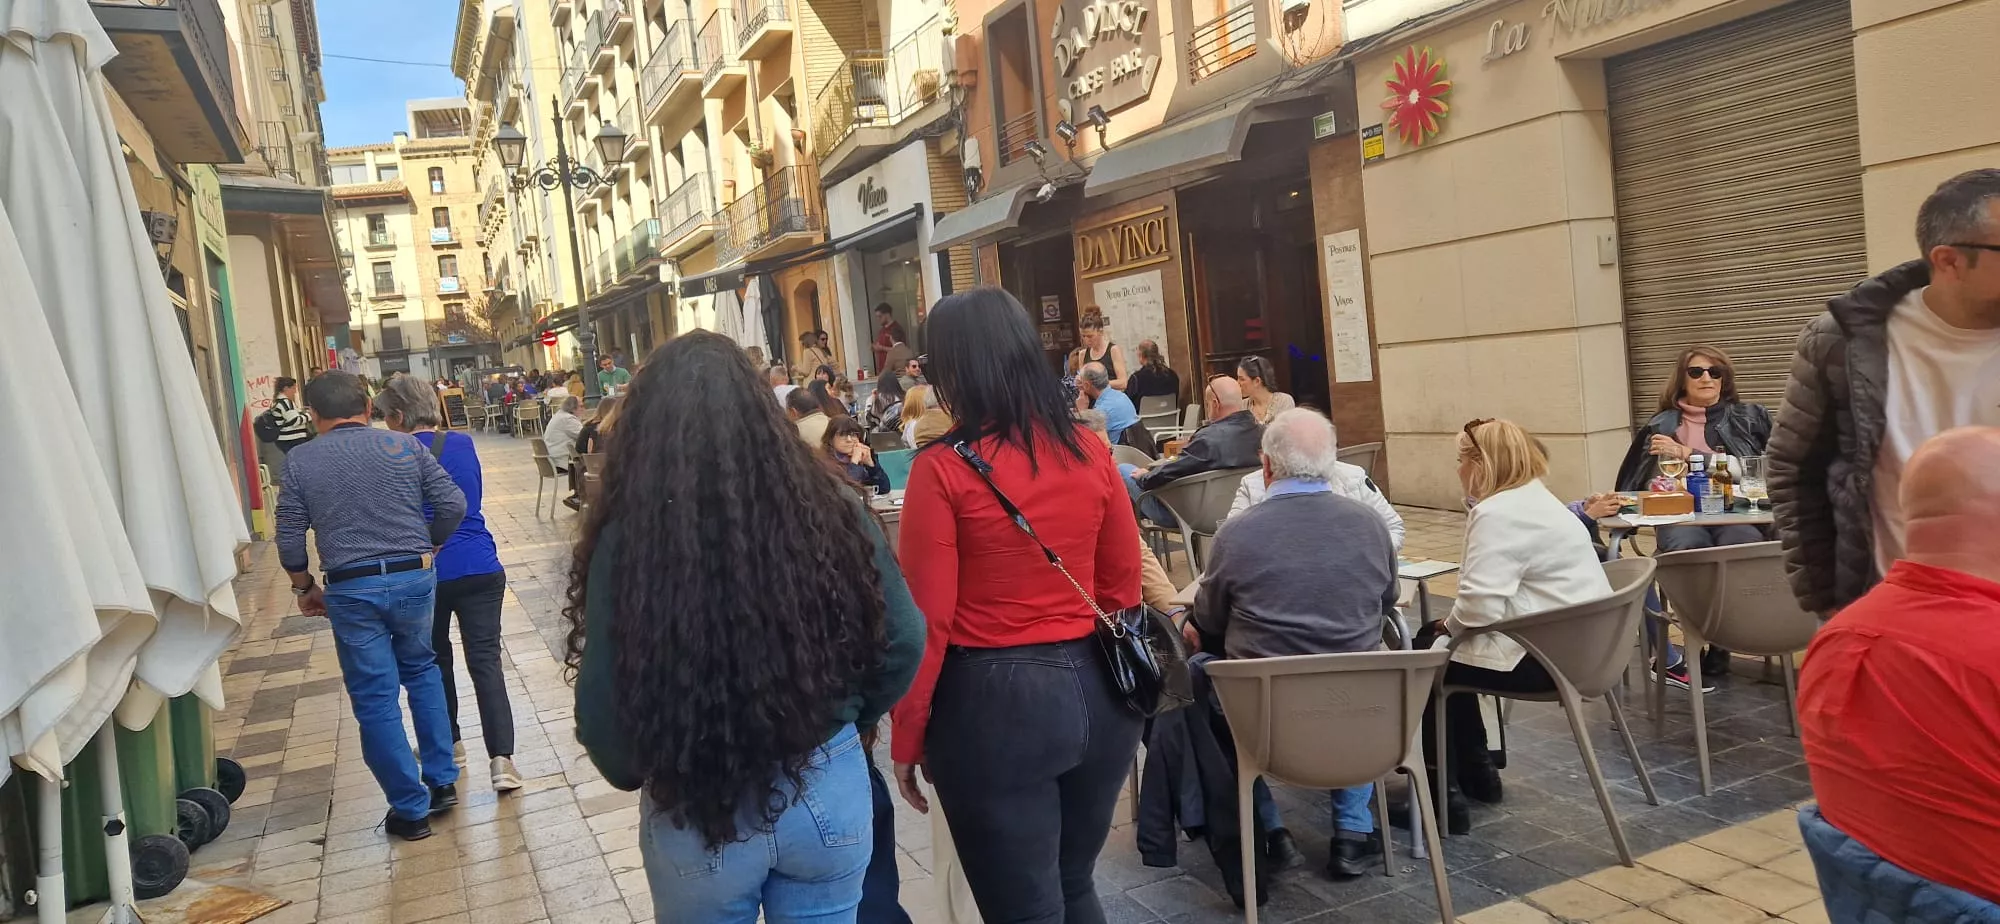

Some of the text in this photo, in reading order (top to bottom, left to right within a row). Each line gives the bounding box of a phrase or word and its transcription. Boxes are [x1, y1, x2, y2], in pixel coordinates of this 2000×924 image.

[1054, 0, 1148, 77] DA VINCI
[1481, 19, 1531, 63] La
[1109, 47, 1144, 81] BAR
[1079, 217, 1168, 271] DA VINCI
